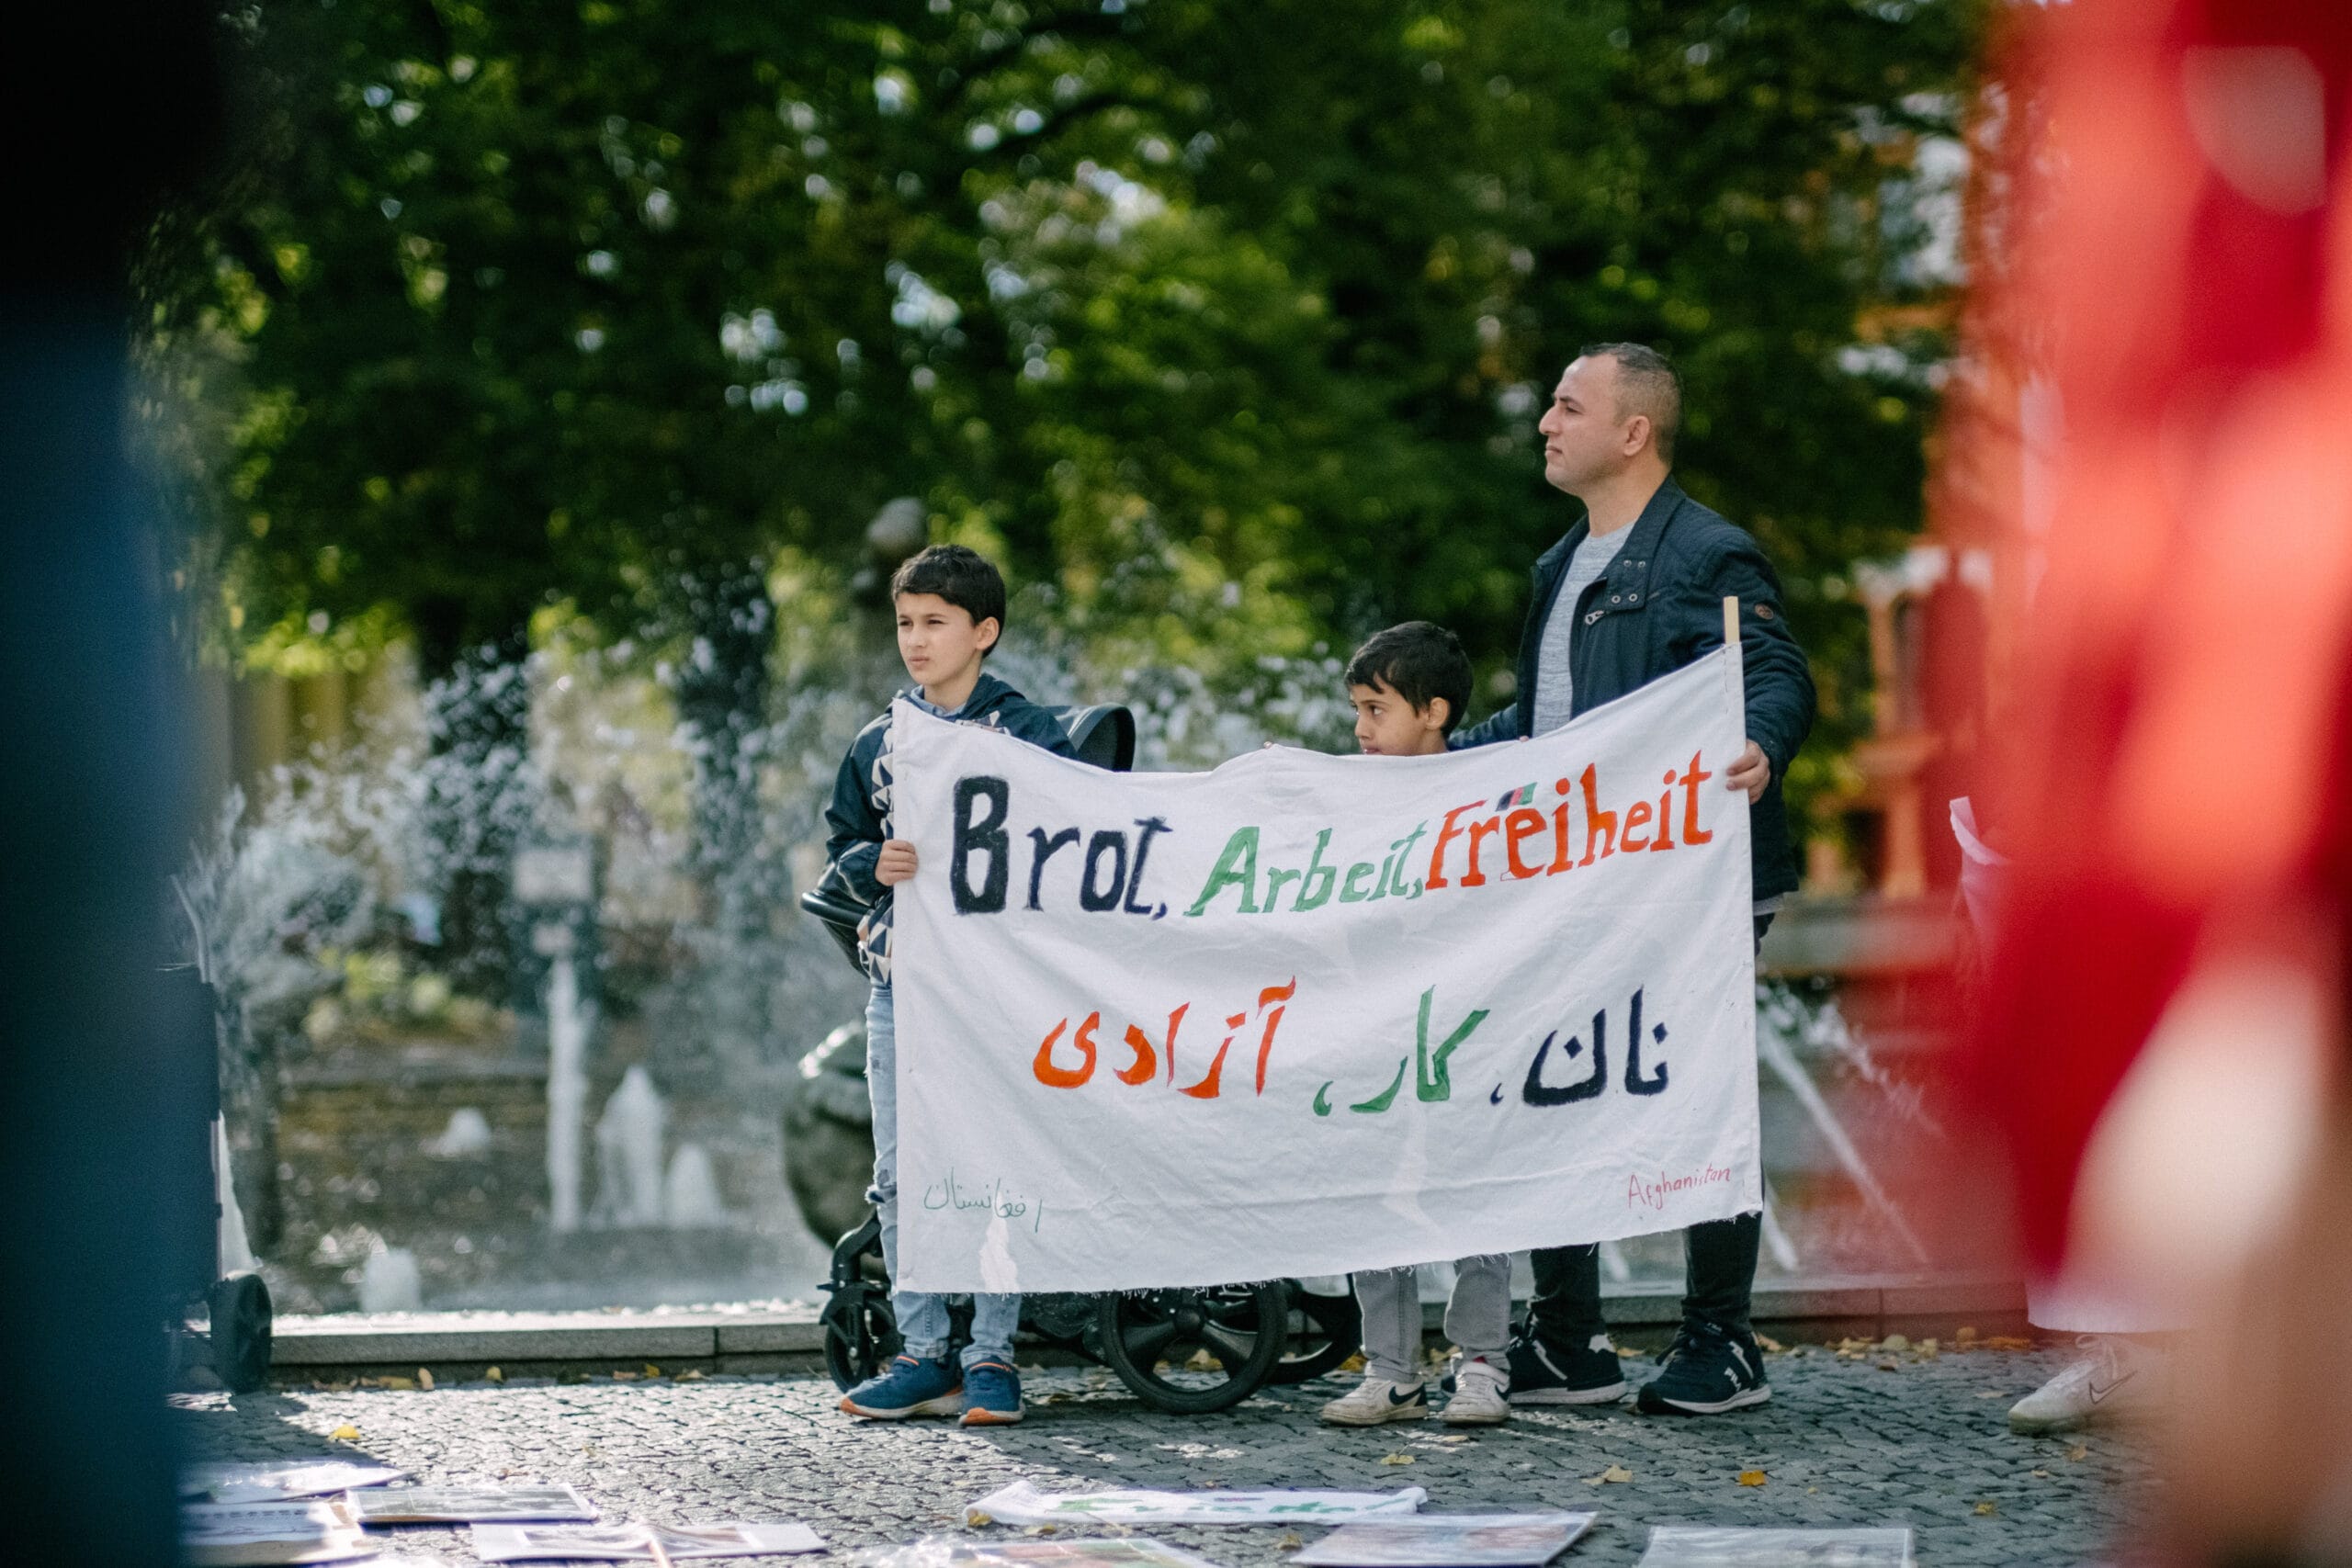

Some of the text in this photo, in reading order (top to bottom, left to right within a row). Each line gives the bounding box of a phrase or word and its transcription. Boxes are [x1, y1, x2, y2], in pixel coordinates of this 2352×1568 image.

[950, 750, 1713, 920] Brot, Arbeit, Freiheit
[1033, 975, 1296, 1099] آزادی
[923, 1167, 1043, 1234] افغانستان
[1628, 1163, 1731, 1211] Afghanistan
